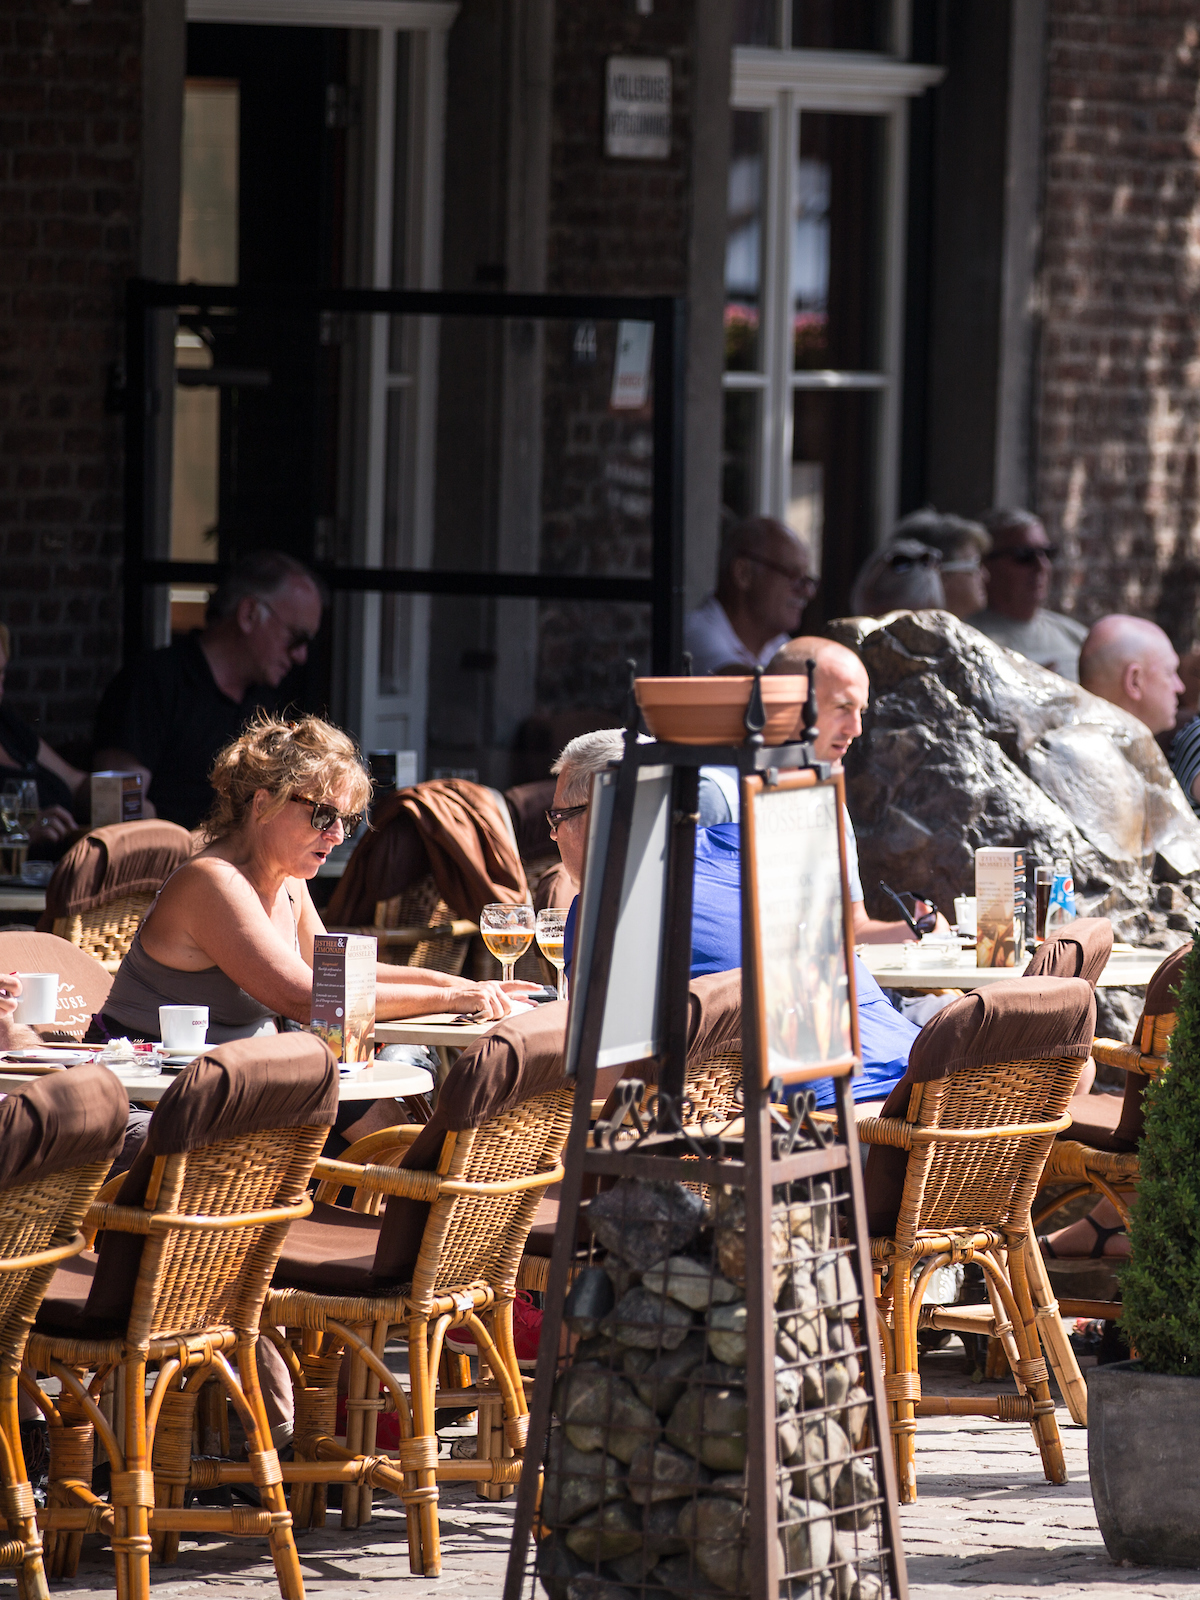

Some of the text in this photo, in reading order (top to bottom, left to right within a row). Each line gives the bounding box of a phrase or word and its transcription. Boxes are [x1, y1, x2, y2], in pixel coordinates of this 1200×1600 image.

[755, 803, 836, 835] MOSSELEN
[337, 937, 345, 948] &
[55, 995, 87, 1010] EUSE
